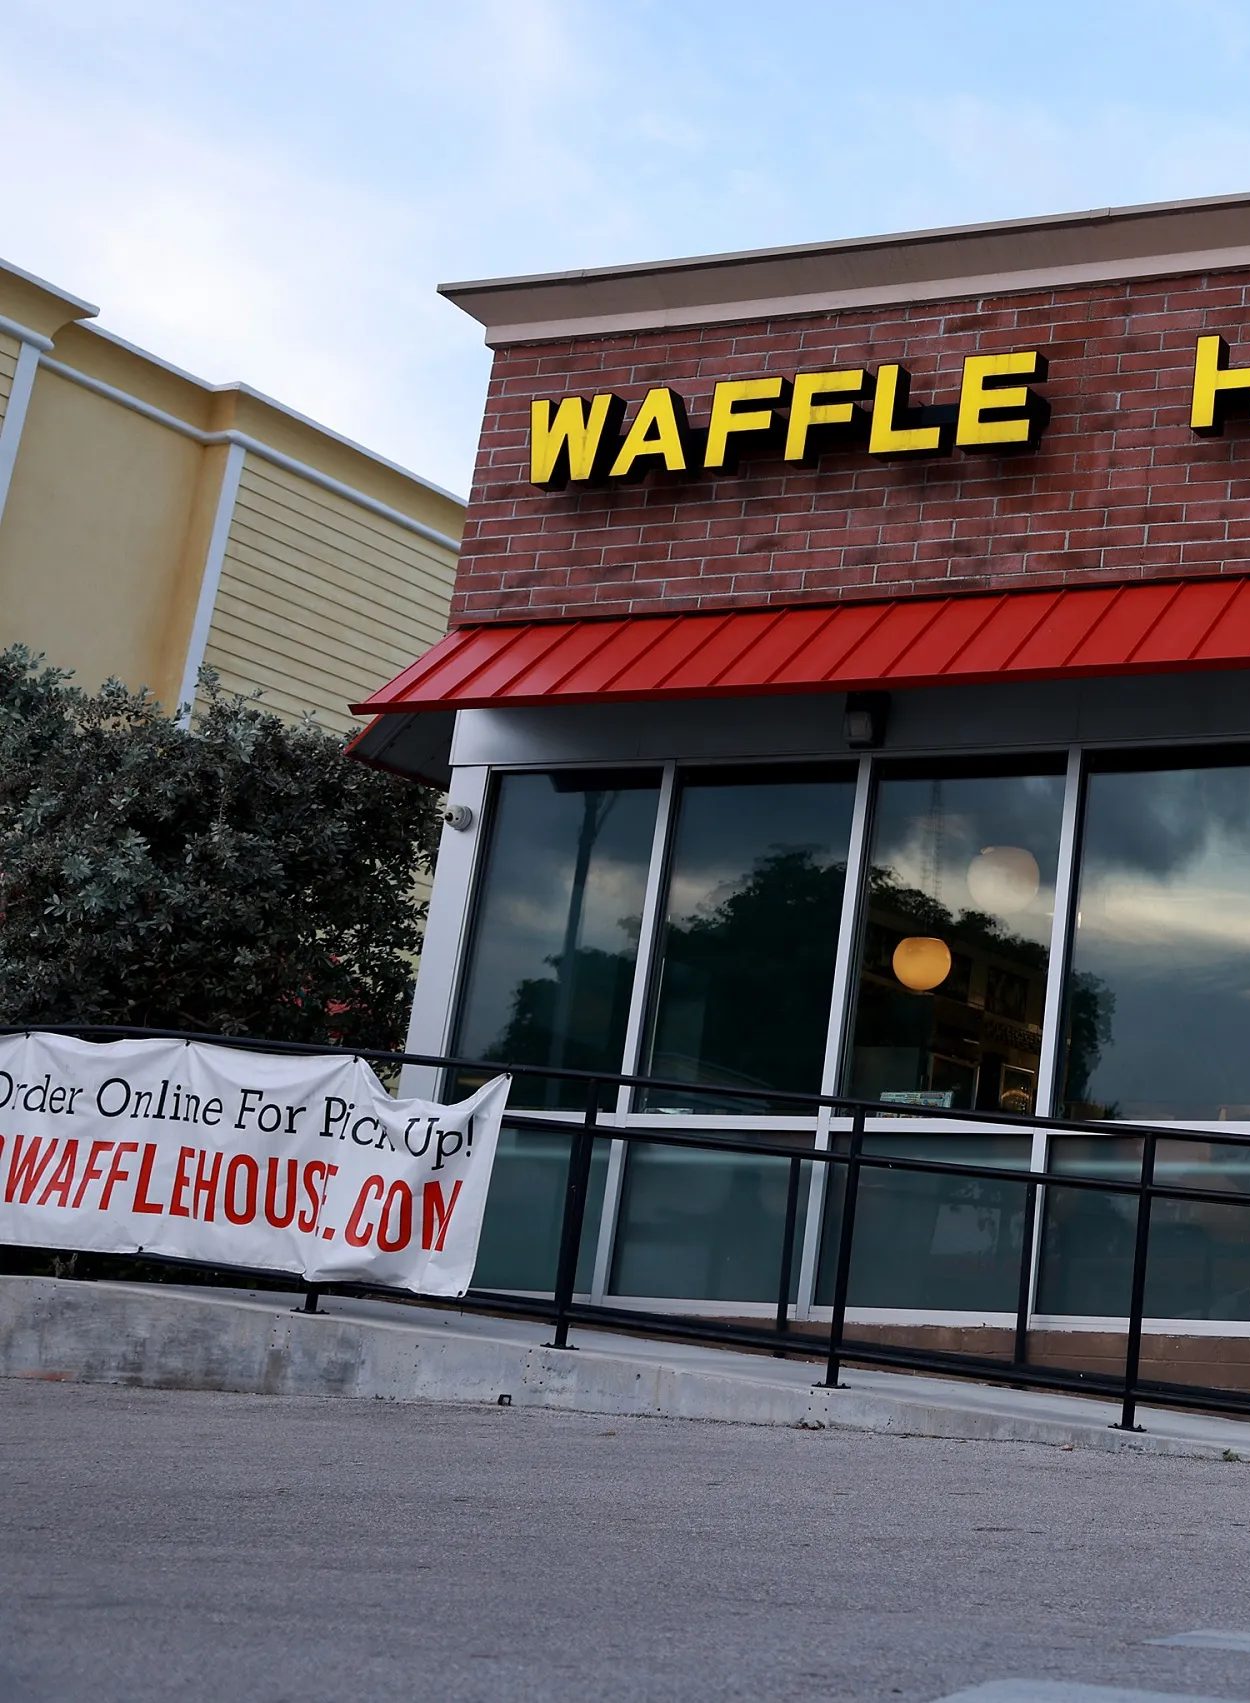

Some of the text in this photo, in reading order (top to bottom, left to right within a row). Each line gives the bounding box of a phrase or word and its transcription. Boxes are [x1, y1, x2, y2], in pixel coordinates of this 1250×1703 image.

[530, 351, 1037, 484] WAFFLE
[96, 1077, 223, 1126] Online
[234, 1089, 306, 1134] For
[404, 1114, 475, 1171] Up!
[0, 1134, 463, 1252] WAFFLEHOUSE.COM
